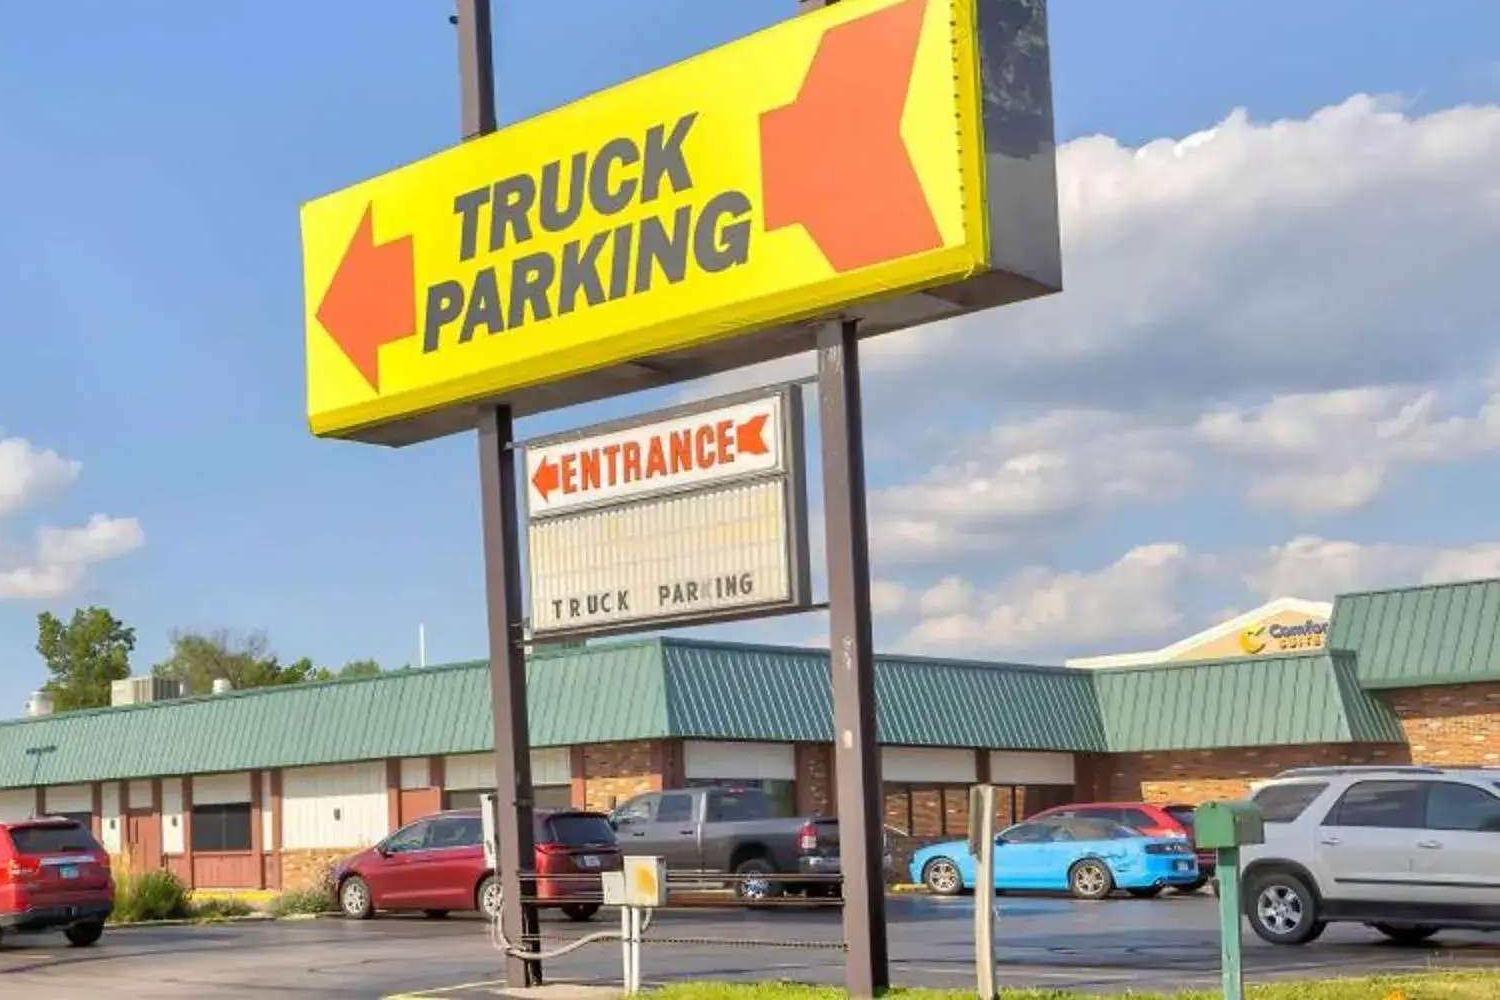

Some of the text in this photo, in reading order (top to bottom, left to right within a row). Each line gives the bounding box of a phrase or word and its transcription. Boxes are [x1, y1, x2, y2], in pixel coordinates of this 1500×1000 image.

[453, 111, 699, 262] TRUCK
[422, 191, 753, 354] PARKING
[561, 419, 736, 495] ENTRANCE
[552, 572, 754, 620] TRUCK PARKING
[1269, 618, 1329, 638] Comfor
[1280, 634, 1323, 649] SUITE
